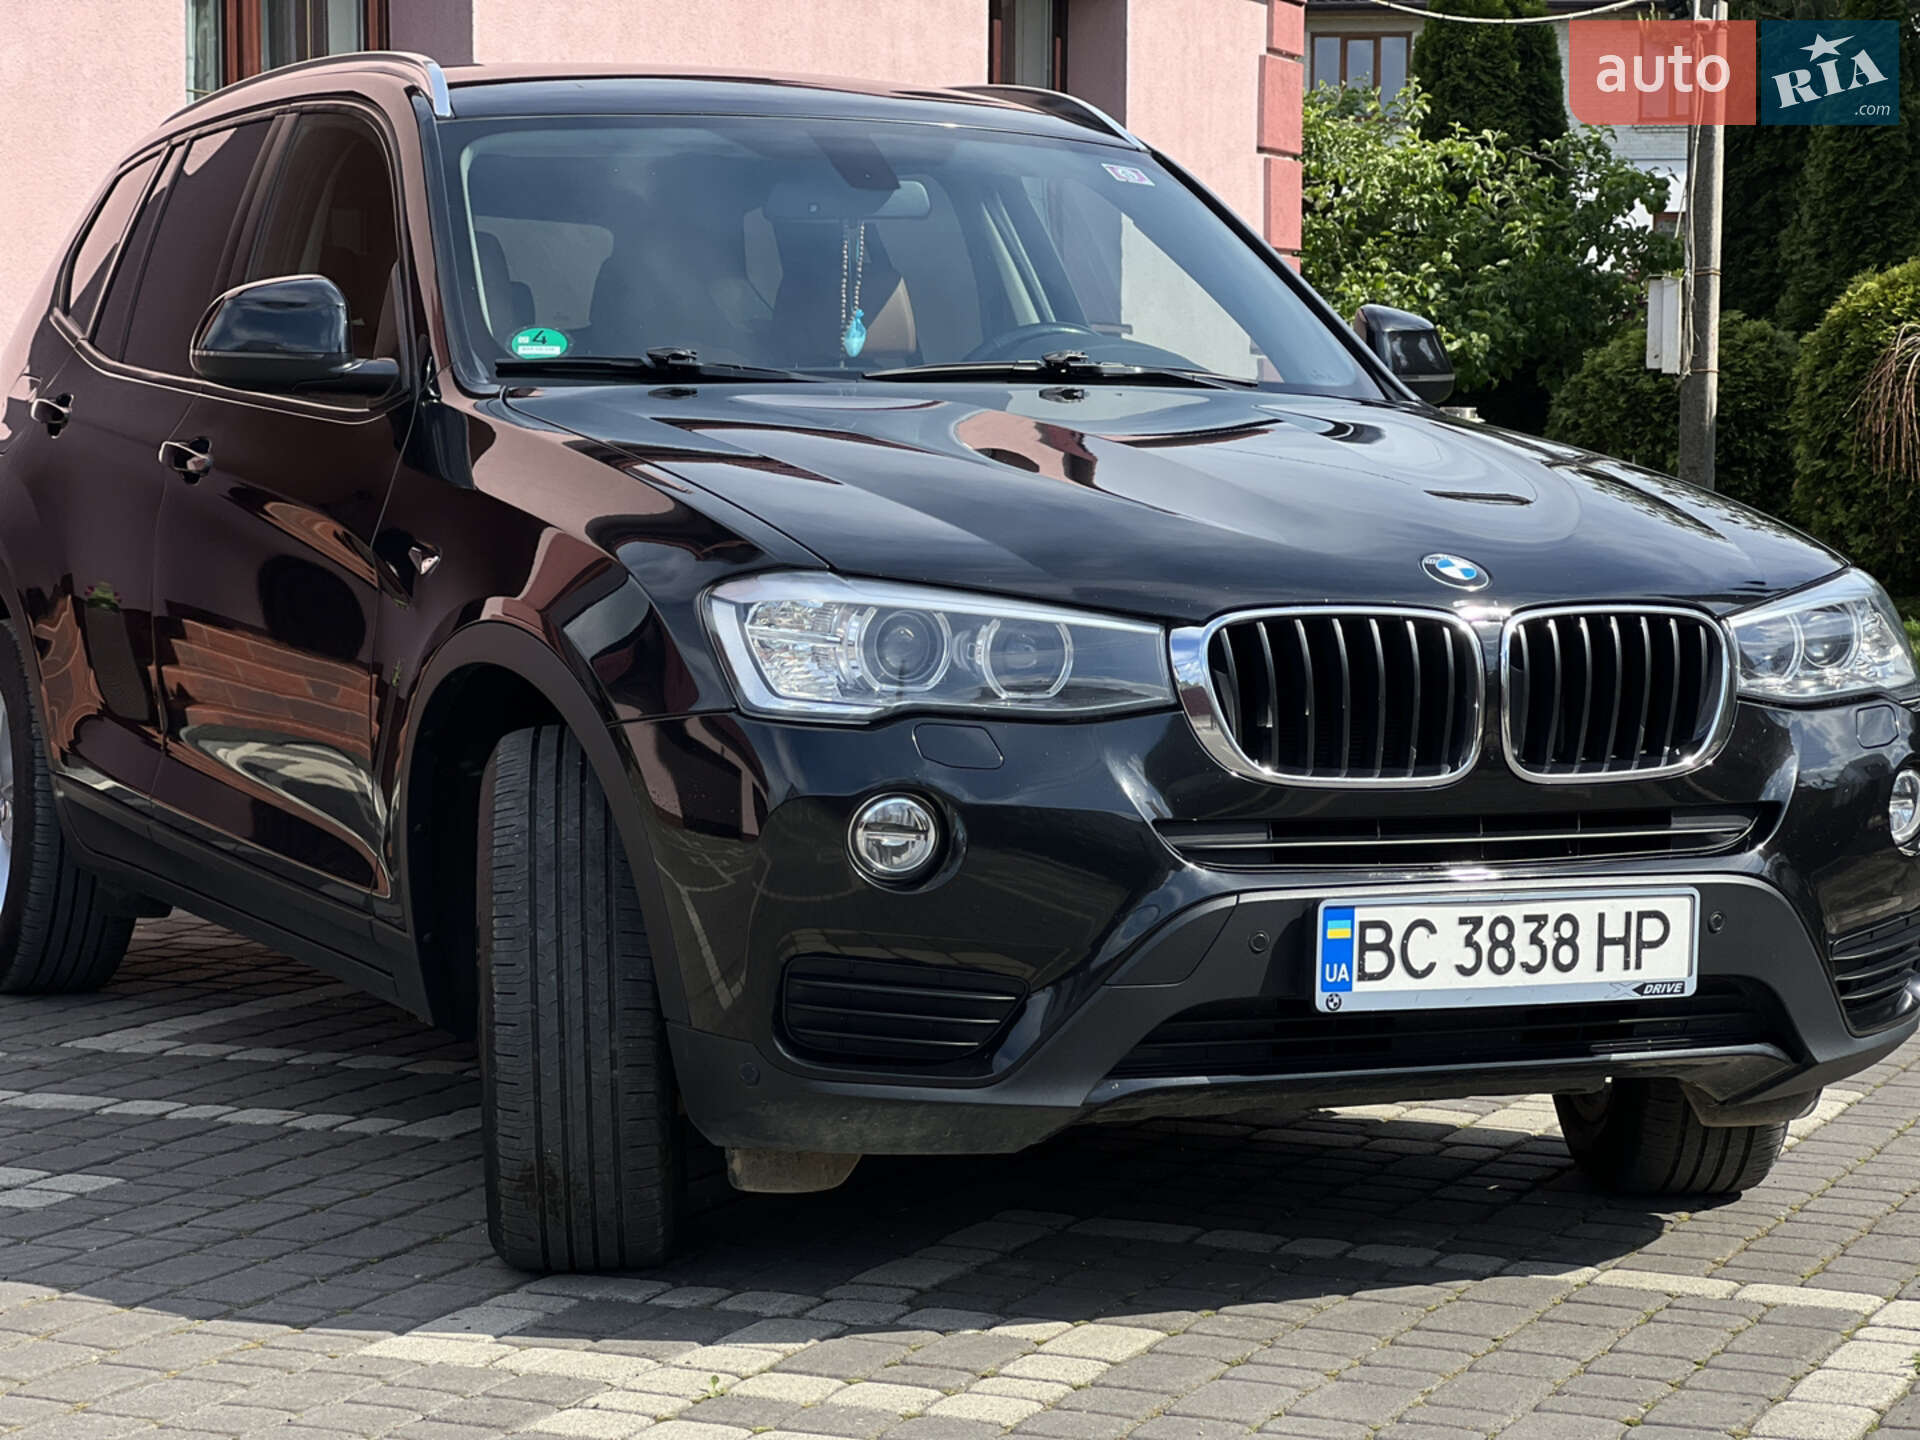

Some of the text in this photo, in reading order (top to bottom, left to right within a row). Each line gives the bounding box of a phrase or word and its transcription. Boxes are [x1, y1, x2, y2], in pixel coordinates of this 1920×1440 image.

[532, 330, 547, 344] 4
[1357, 909, 1671, 982] BC 3838 HP
[1325, 962, 1350, 983] UA
